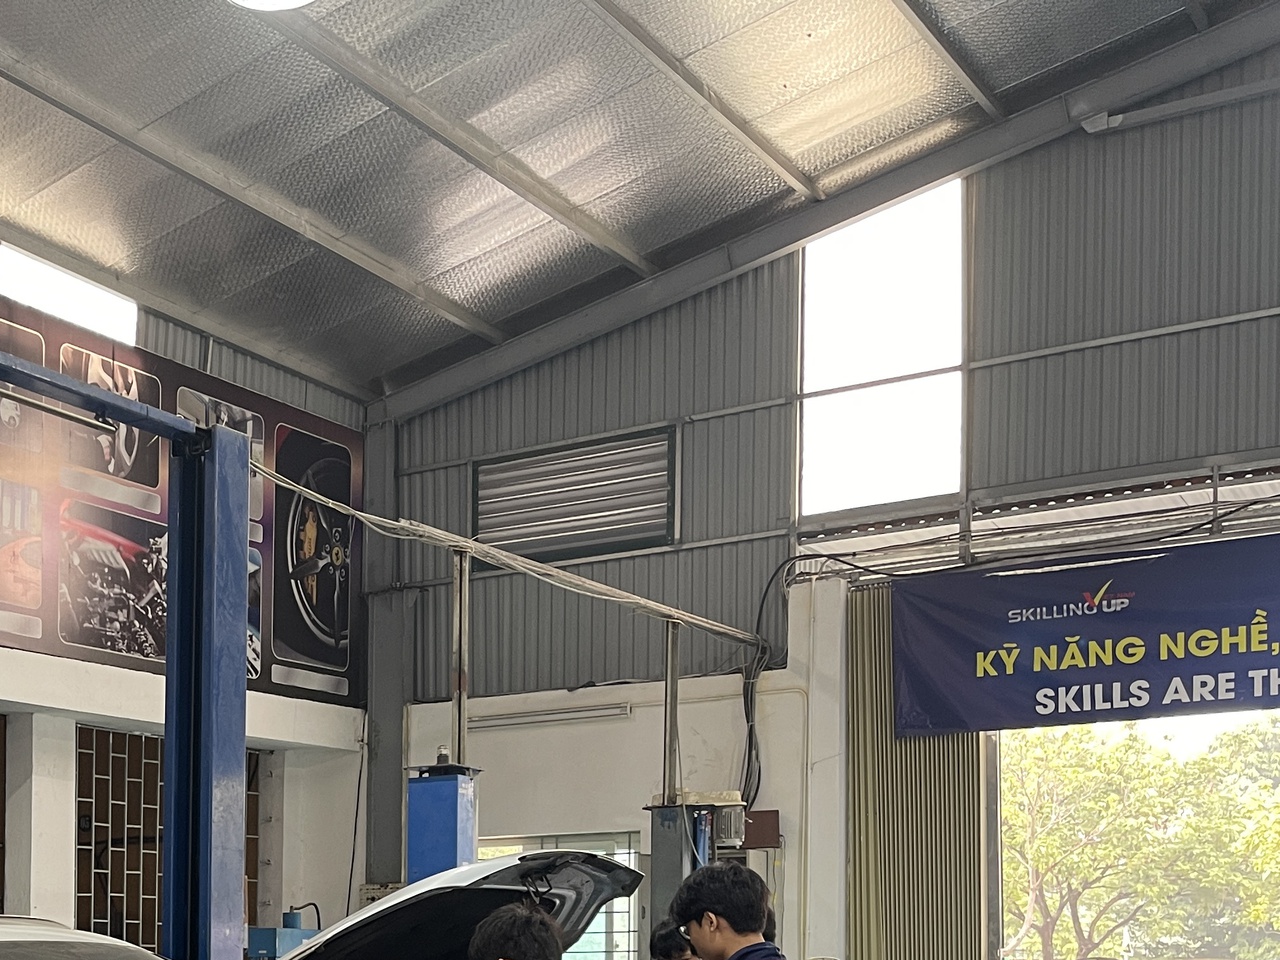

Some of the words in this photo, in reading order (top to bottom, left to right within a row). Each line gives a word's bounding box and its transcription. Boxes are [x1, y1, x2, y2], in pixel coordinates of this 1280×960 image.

[1007, 602, 1098, 623] SKILLING
[1102, 598, 1130, 613] UP
[976, 643, 1020, 677] KỸ
[1033, 635, 1146, 672] NĂNG
[1159, 608, 1280, 661] NGHỀ,
[1035, 679, 1150, 715] SKILLS
[1162, 672, 1236, 705] ARE
